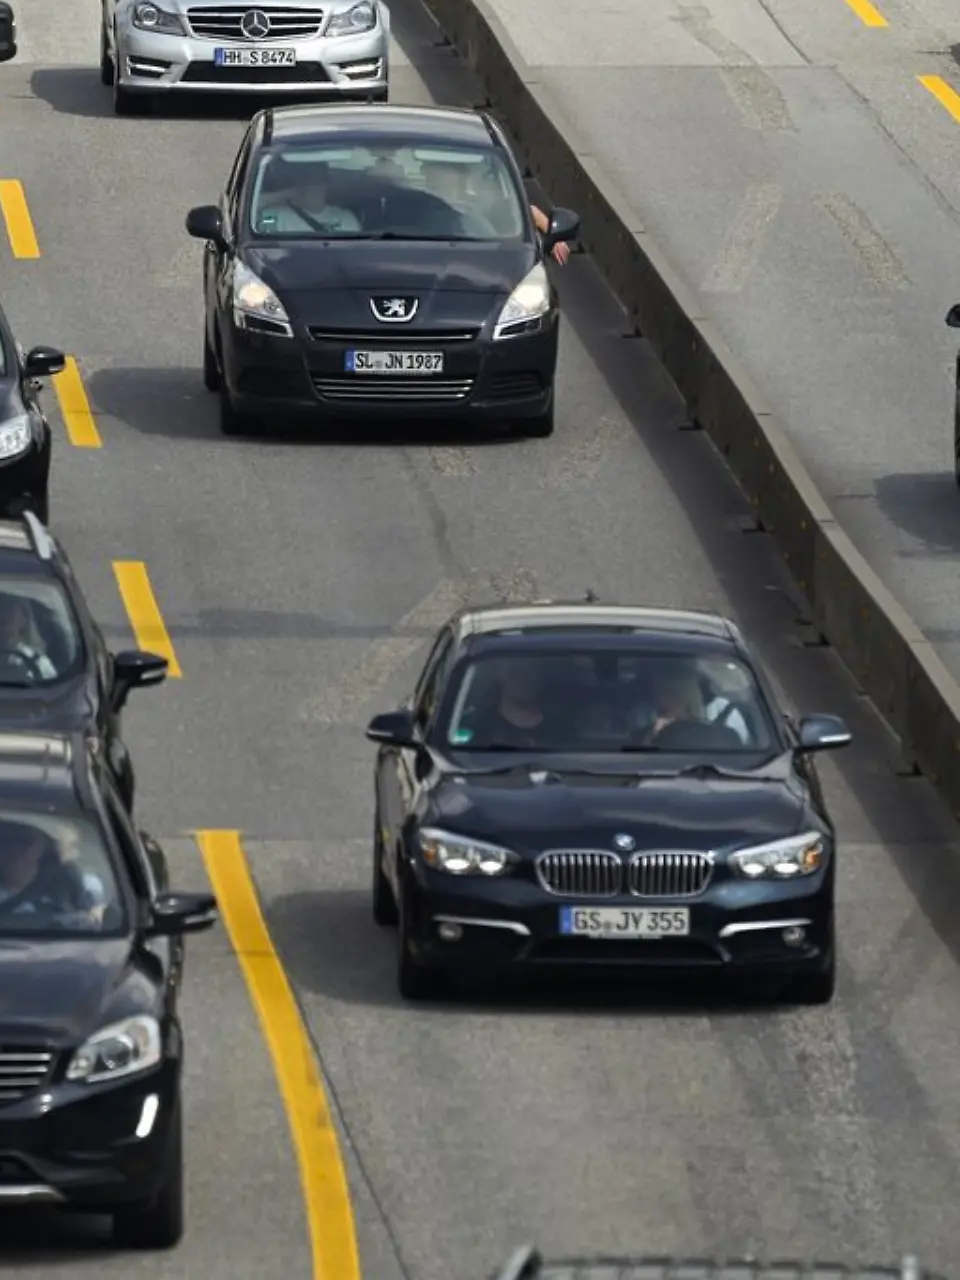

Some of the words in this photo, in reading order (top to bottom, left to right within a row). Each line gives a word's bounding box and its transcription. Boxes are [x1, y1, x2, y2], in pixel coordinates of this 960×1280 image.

[223, 51, 241, 63] HH
[250, 51, 258, 64] S
[261, 51, 293, 64] 8474
[356, 353, 373, 368] SL
[385, 353, 403, 369] JN
[406, 354, 441, 369] 1987
[574, 911, 600, 930] GS
[616, 911, 643, 931] JY
[647, 911, 685, 931] 355
